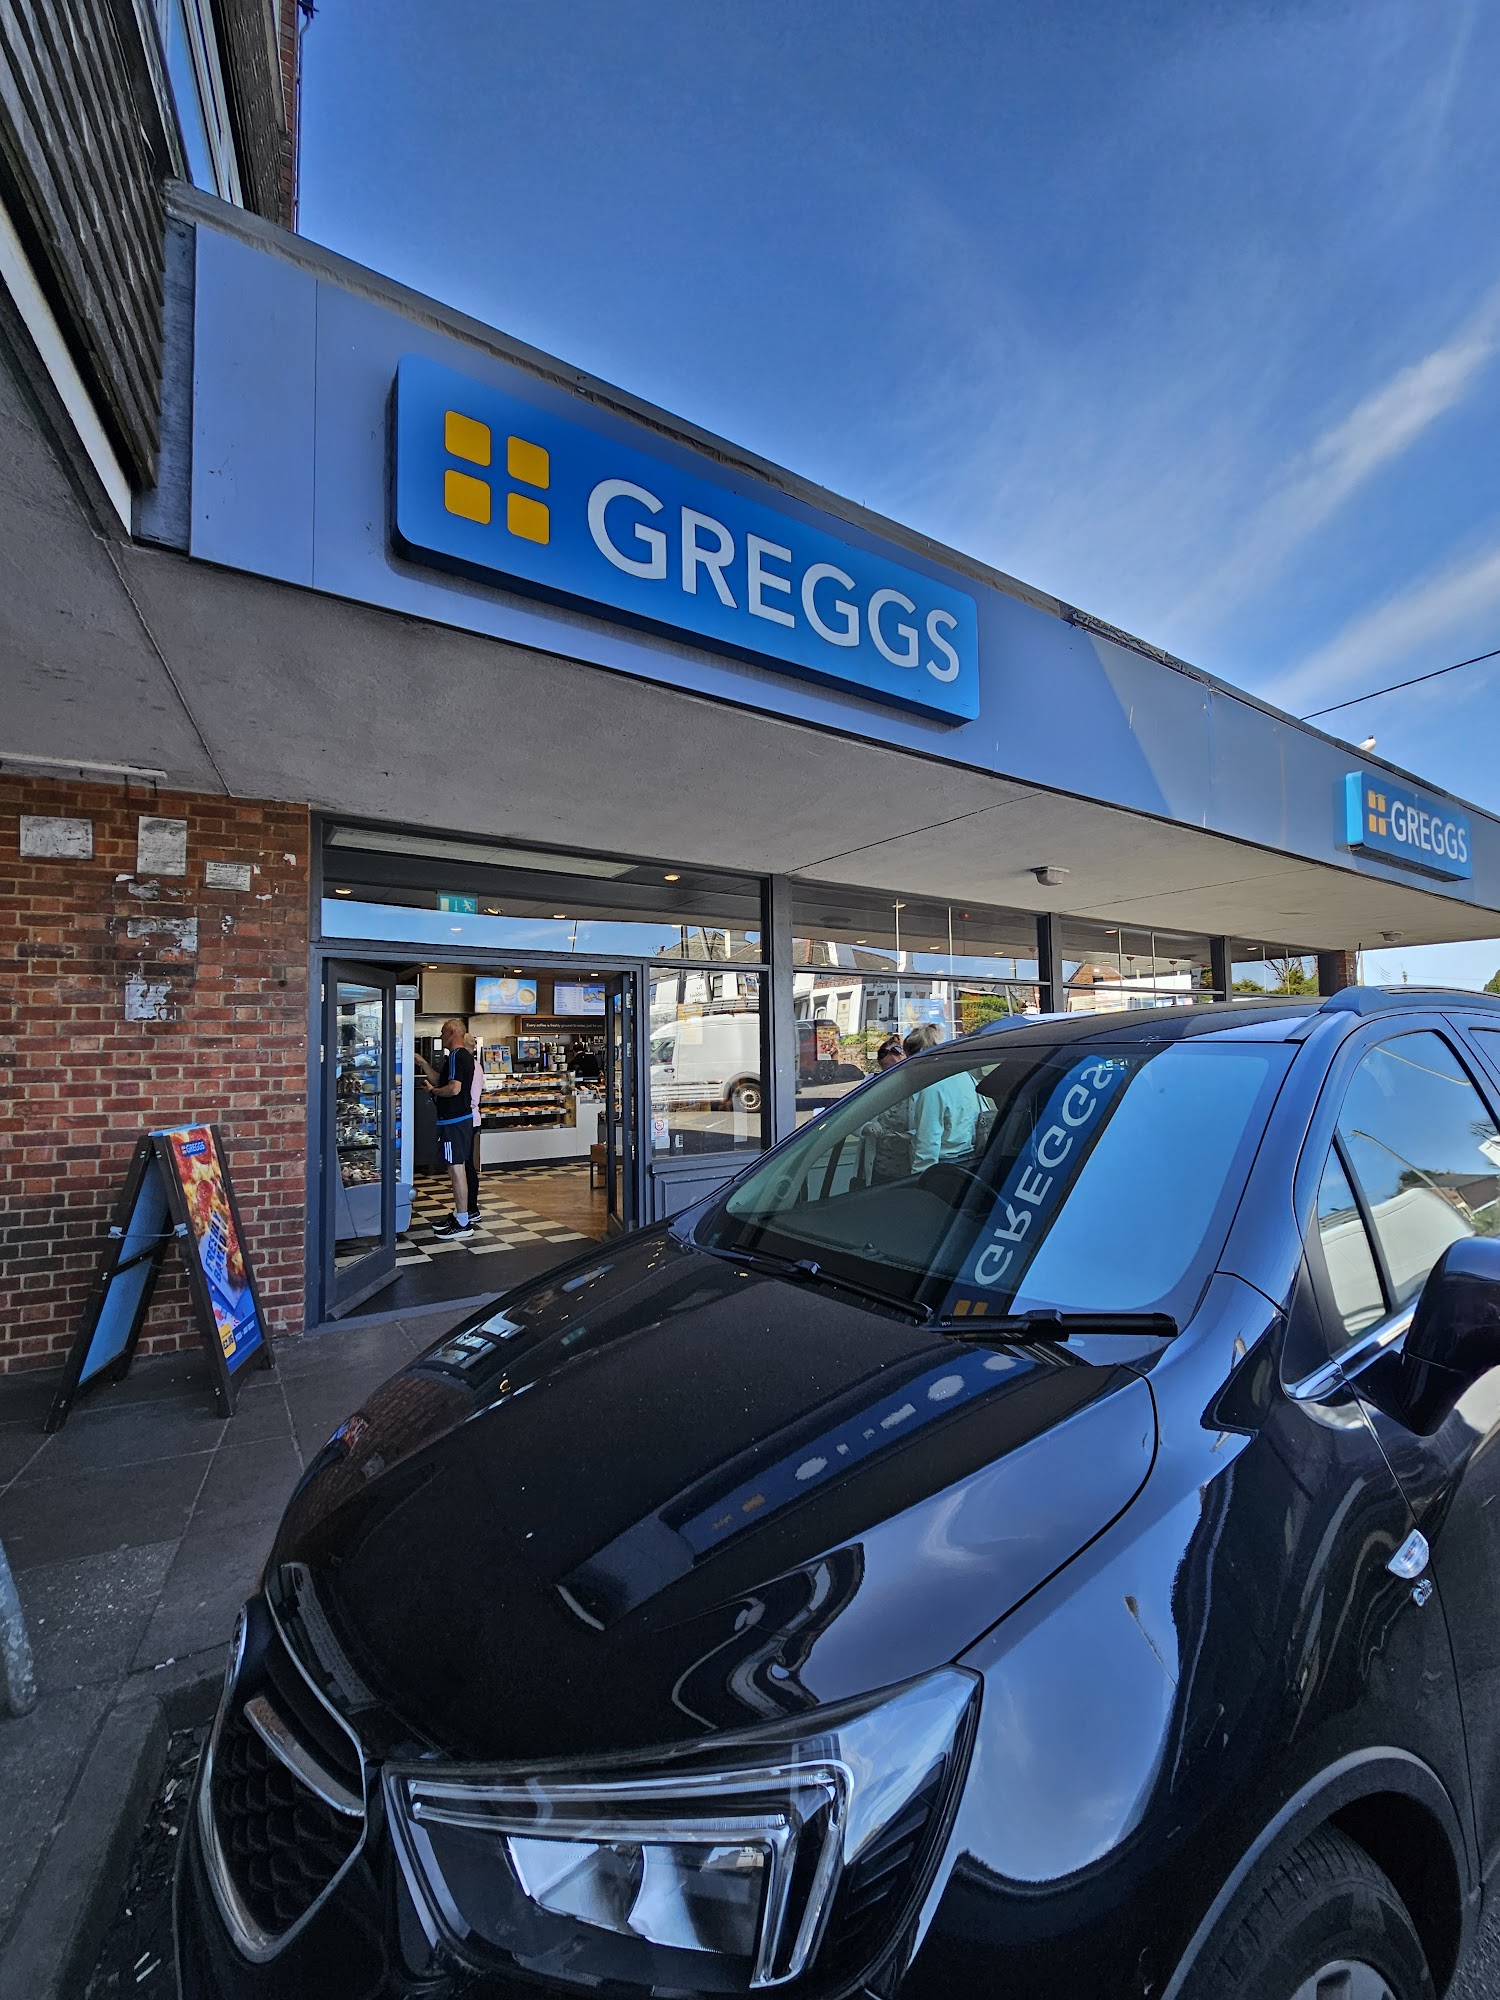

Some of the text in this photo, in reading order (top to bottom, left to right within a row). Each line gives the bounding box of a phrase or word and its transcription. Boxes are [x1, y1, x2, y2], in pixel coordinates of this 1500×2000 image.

[587, 478, 960, 683] GREGGS
[1390, 800, 1469, 864] GREGGS
[186, 1141, 205, 1153] GREGGS
[205, 1208, 221, 1272] FRESHLY
[213, 1235, 227, 1283] BAKED
